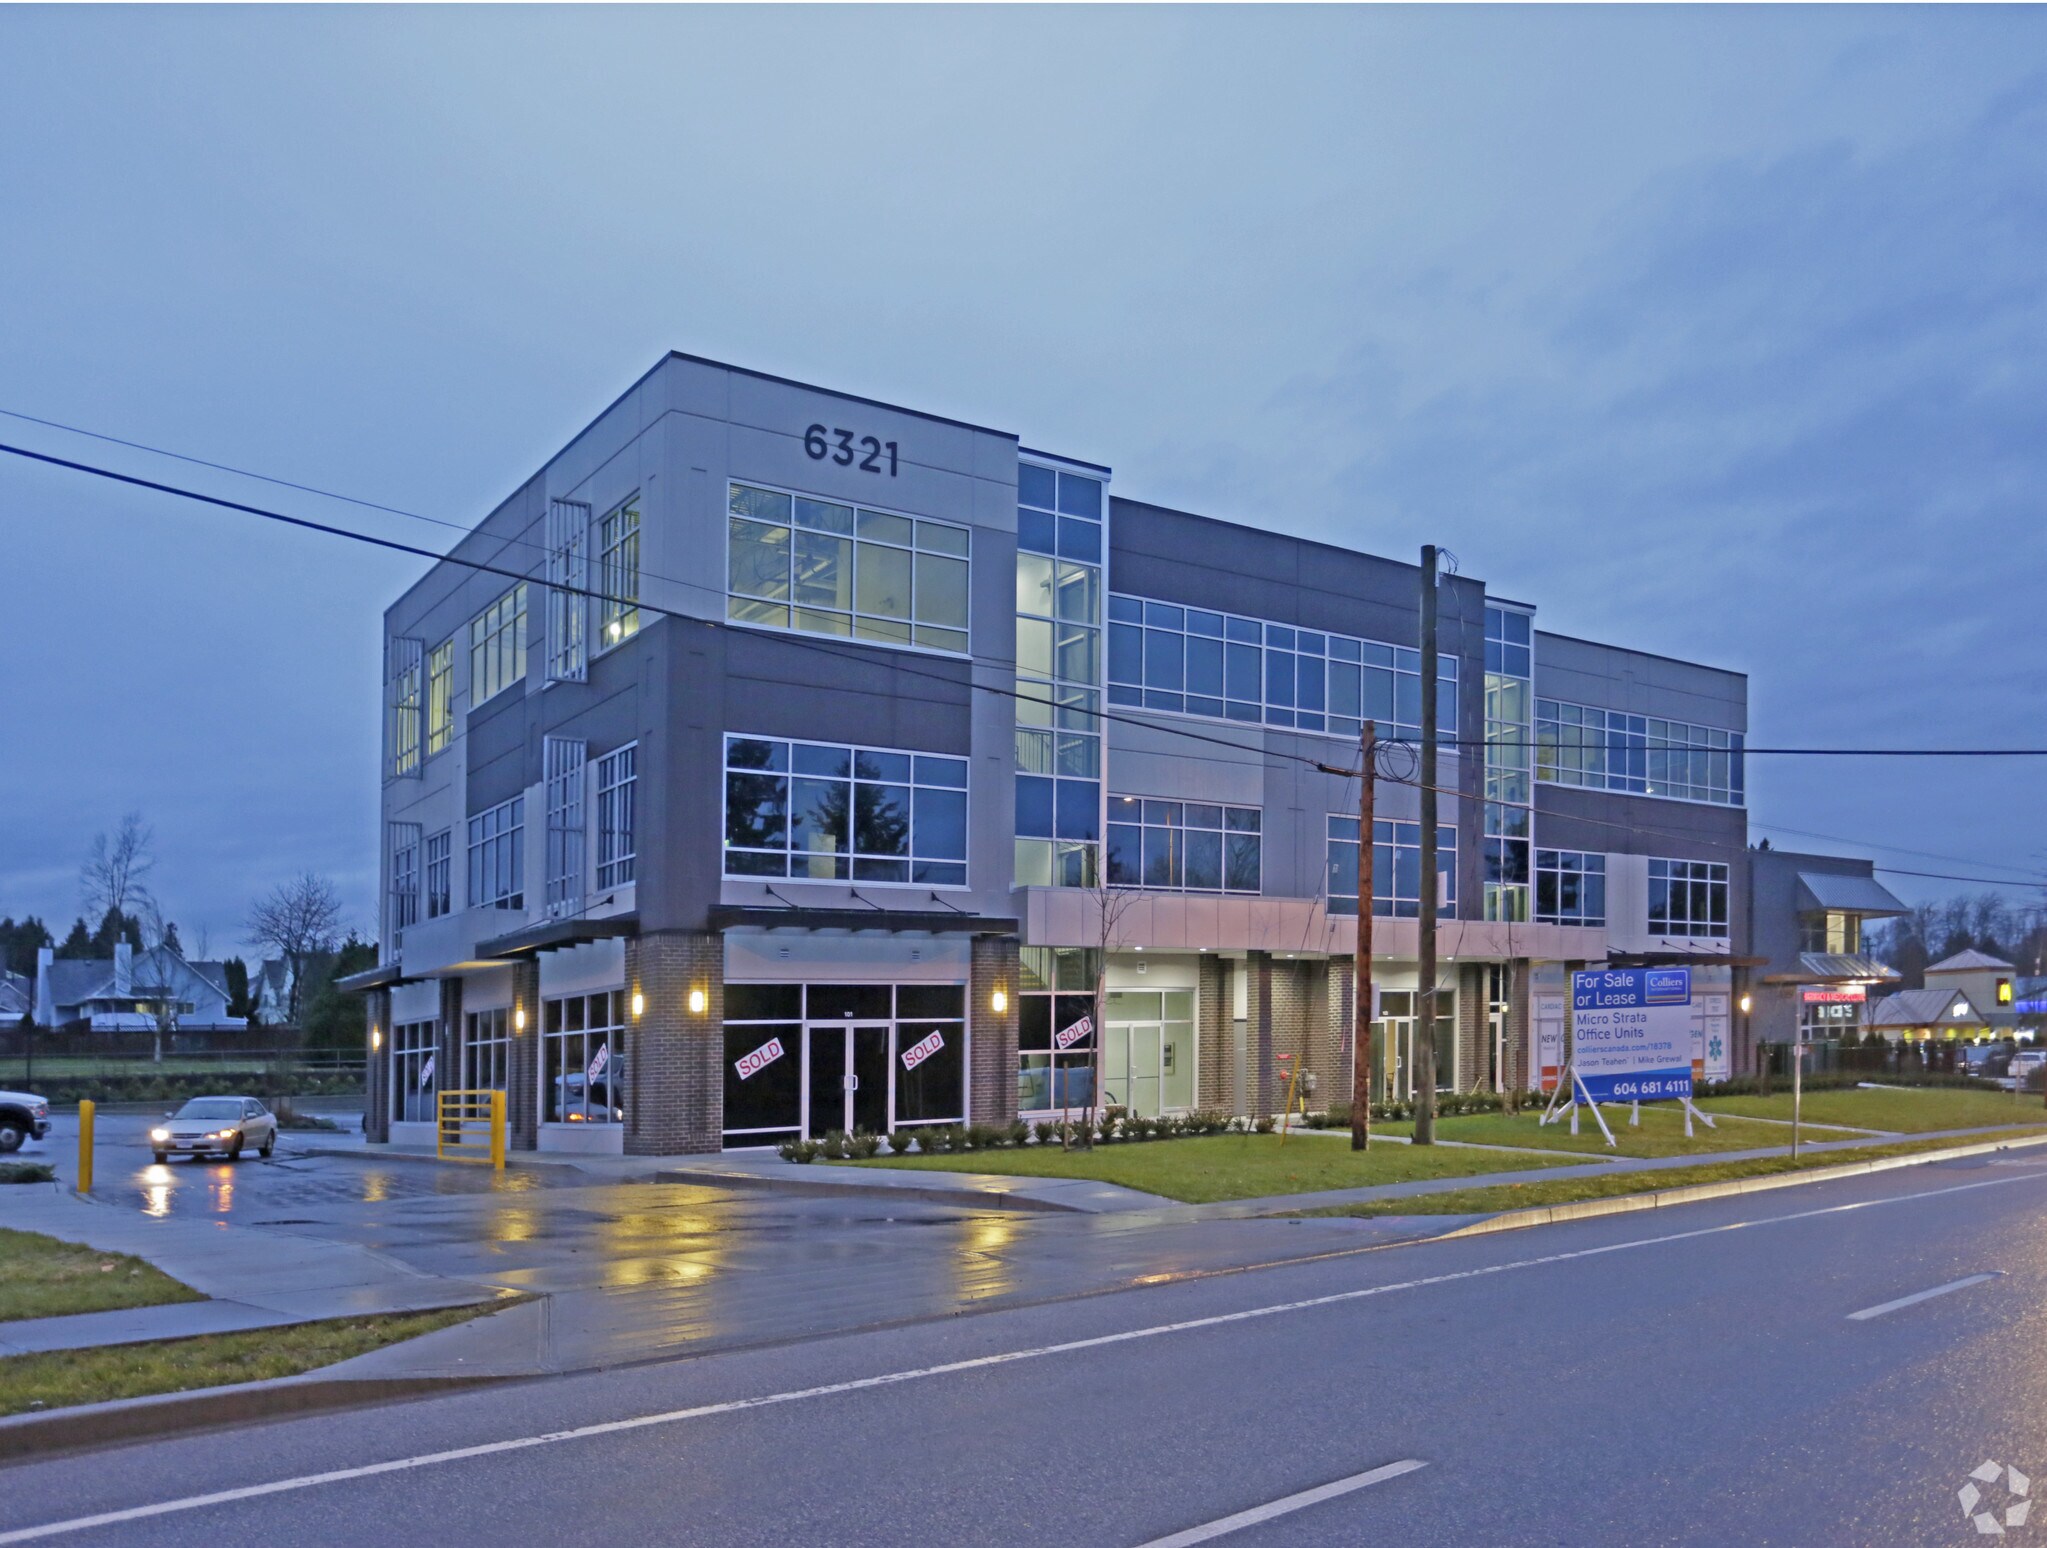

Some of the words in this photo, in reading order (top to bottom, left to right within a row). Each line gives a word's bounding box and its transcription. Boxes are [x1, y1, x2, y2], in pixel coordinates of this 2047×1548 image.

[804, 423, 898, 477] 6321
[1576, 974, 1600, 989] For
[1604, 973, 1634, 988] Sale
[1649, 977, 1683, 987] Colliers
[1576, 995, 1592, 1007] or
[1596, 991, 1637, 1006] Lease
[1577, 1013, 1609, 1026] Micro
[1612, 1012, 1647, 1025] Strata
[1058, 1019, 1091, 1047] SOLD
[1576, 1028, 1611, 1041] Office
[1614, 1026, 1645, 1039] Units
[904, 1033, 942, 1067] SOLD
[590, 1047, 607, 1081] SOLD
[738, 1041, 781, 1076] SOLD
[1577, 1058, 1600, 1067] Jason
[1638, 1056, 1655, 1064] Mike
[1656, 1054, 1683, 1063] Grewal
[1613, 1082, 1638, 1096] 604
[1641, 1080, 1661, 1094] 681
[1665, 1079, 1690, 1093] 4111
